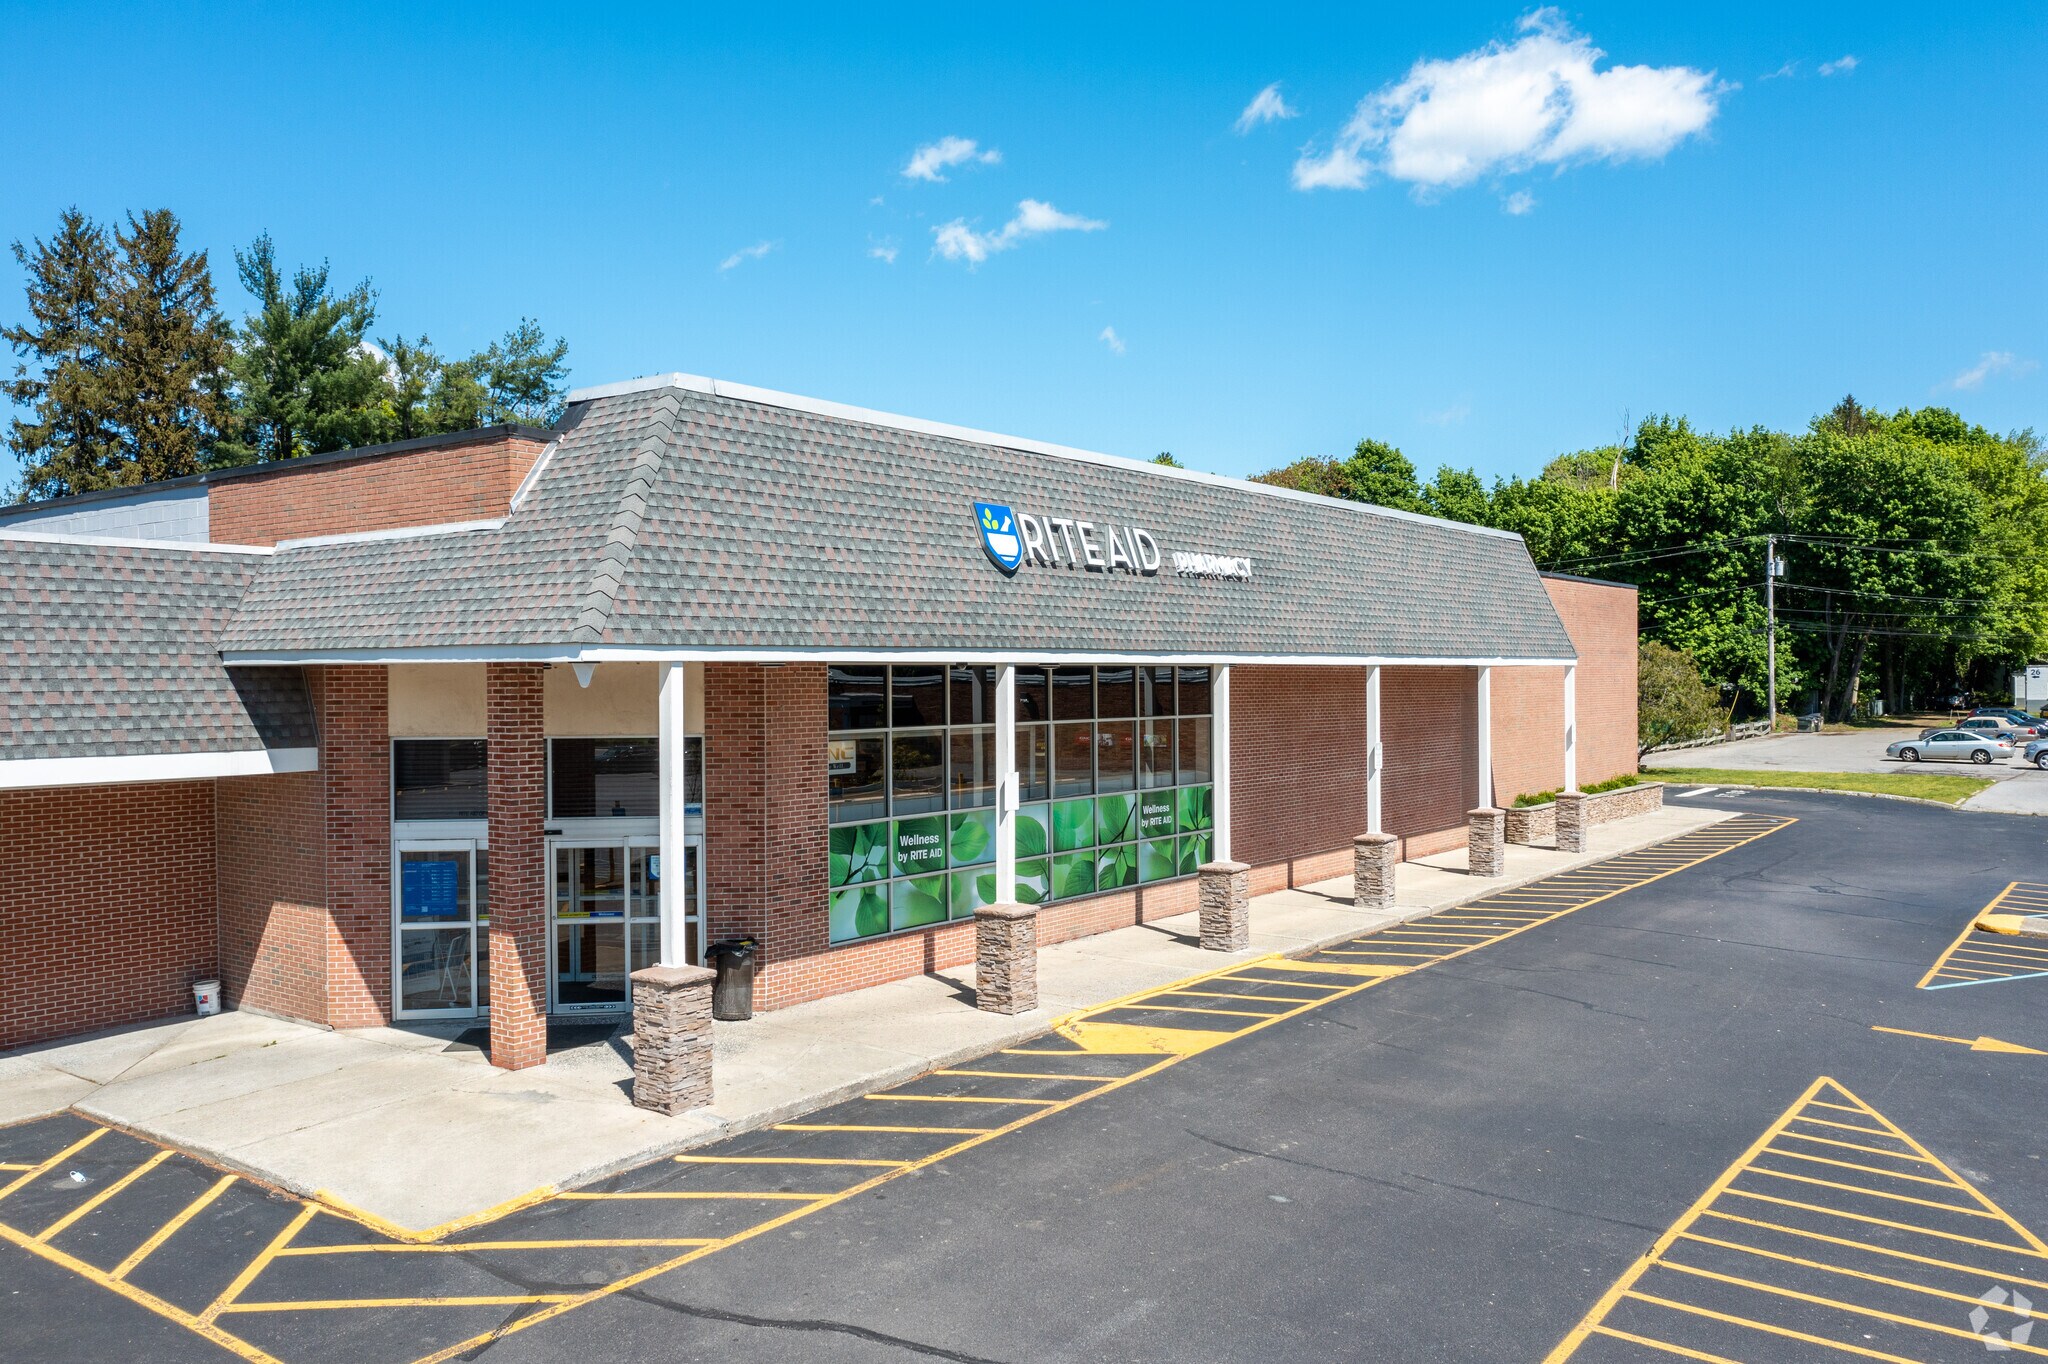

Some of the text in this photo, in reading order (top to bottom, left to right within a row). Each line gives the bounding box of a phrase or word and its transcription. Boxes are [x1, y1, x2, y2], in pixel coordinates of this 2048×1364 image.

[1016, 512, 1161, 573] RITE AID
[1172, 551, 1252, 577] PHARMACY
[1142, 804, 1170, 815] Wellness
[1141, 815, 1172, 828] by RITE AID
[899, 834, 940, 847] Wellness
[897, 848, 943, 863] by RITE AID
